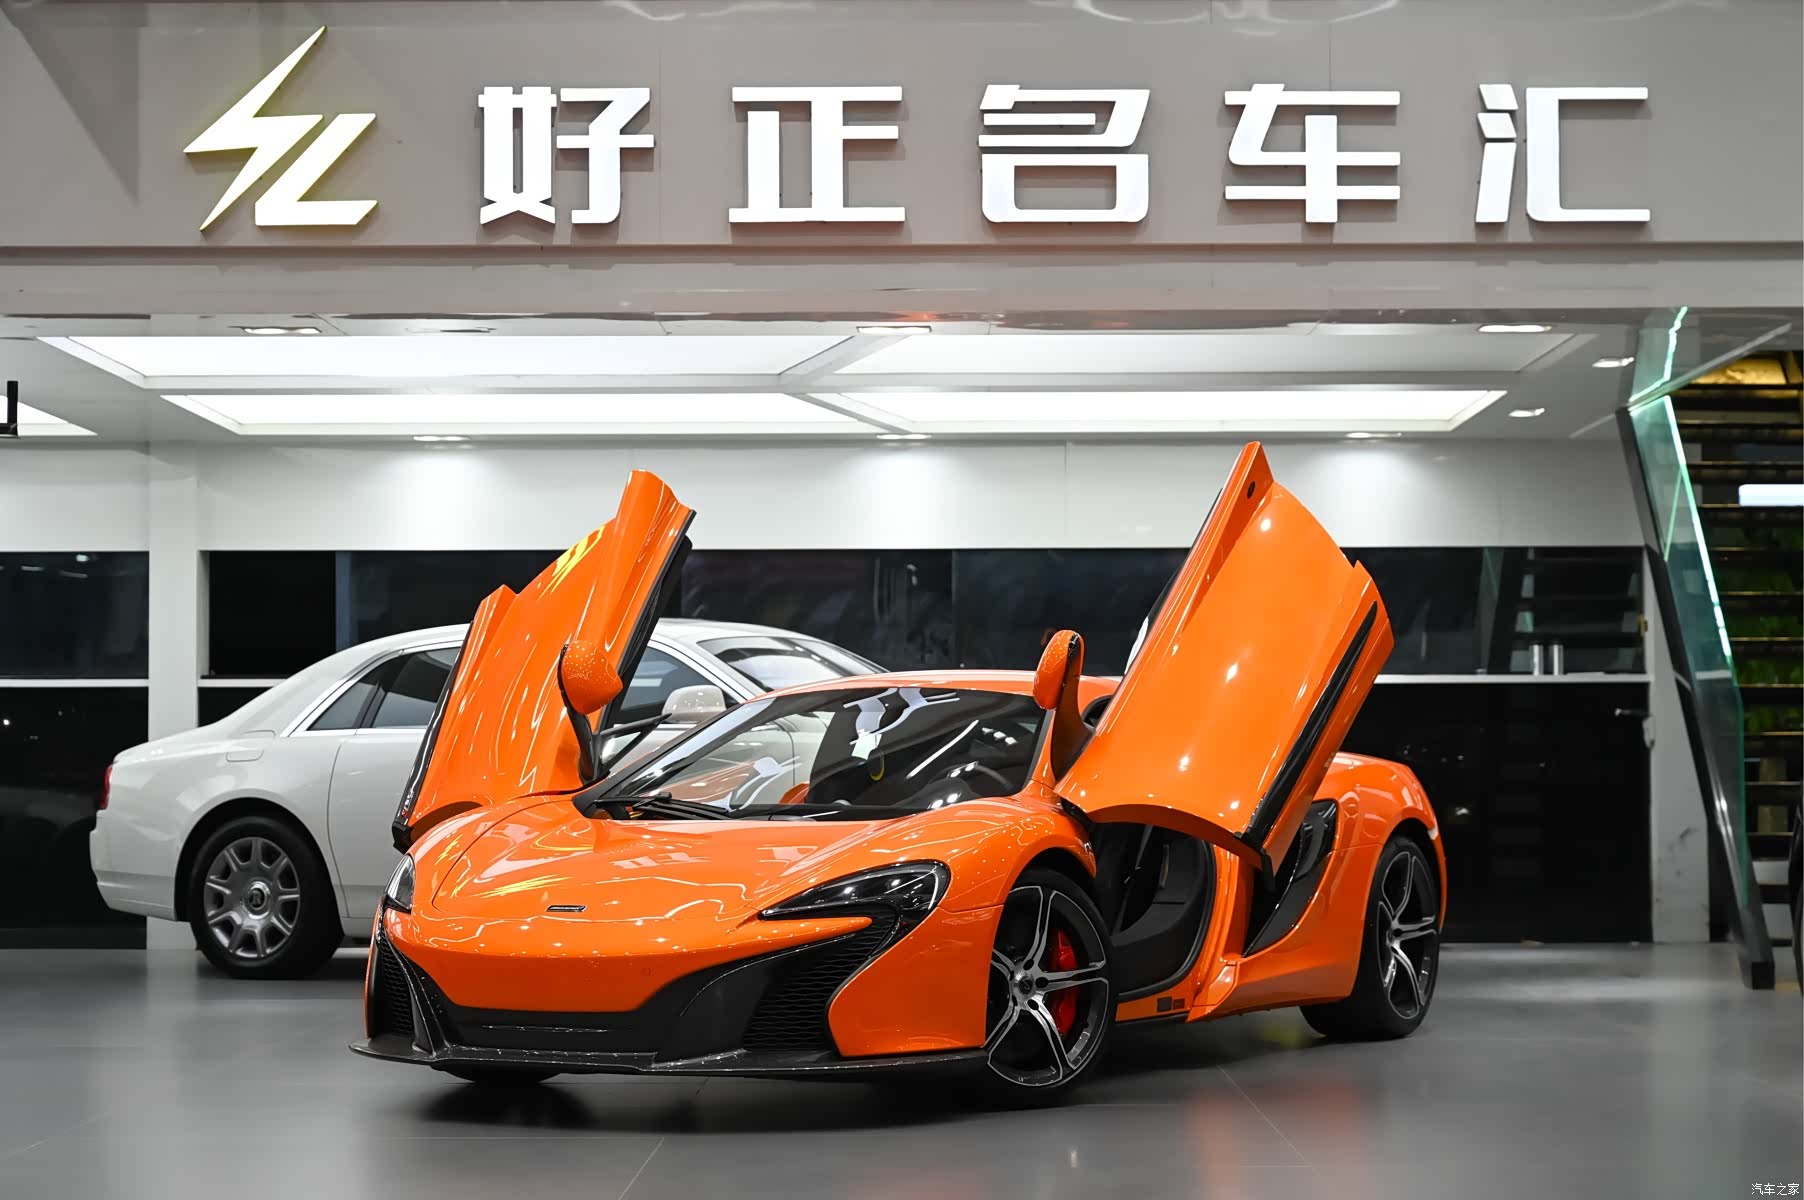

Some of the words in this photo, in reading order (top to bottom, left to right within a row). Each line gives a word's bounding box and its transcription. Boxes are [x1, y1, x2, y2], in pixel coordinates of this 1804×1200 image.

[478, 83, 1651, 225] 好正名车汇
